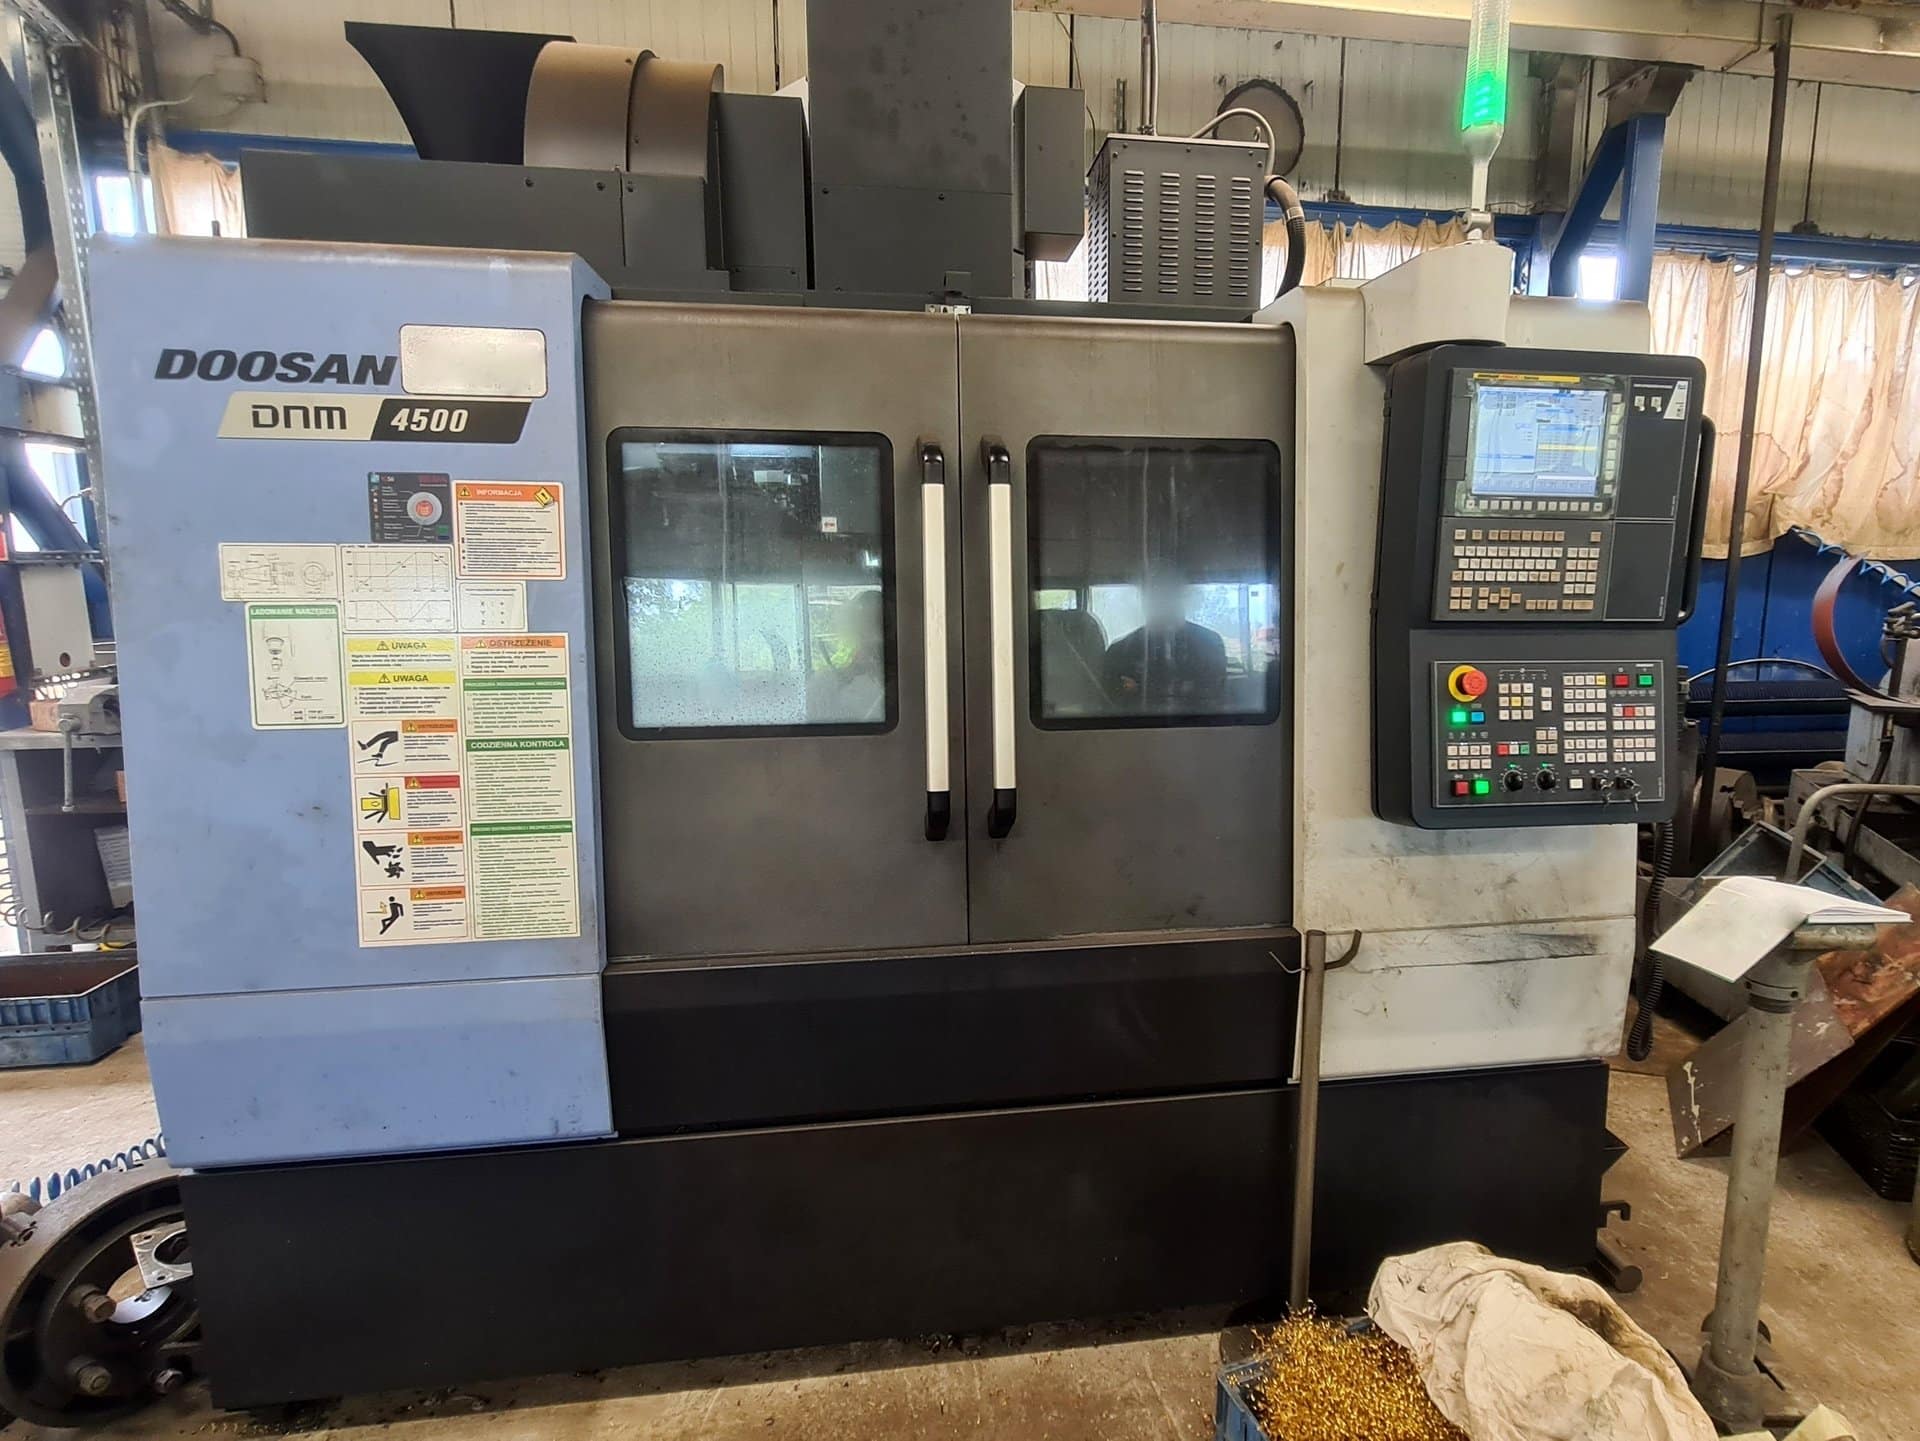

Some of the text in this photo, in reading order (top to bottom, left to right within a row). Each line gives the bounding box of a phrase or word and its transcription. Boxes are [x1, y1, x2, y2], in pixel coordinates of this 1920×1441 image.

[155, 348, 397, 385] DOOSAN
[390, 408, 469, 433] 4500
[476, 489, 523, 497] INFORMACJA
[391, 641, 427, 650] UWAGA
[393, 674, 429, 682] UWAGA
[520, 740, 565, 749] KONTROLA
